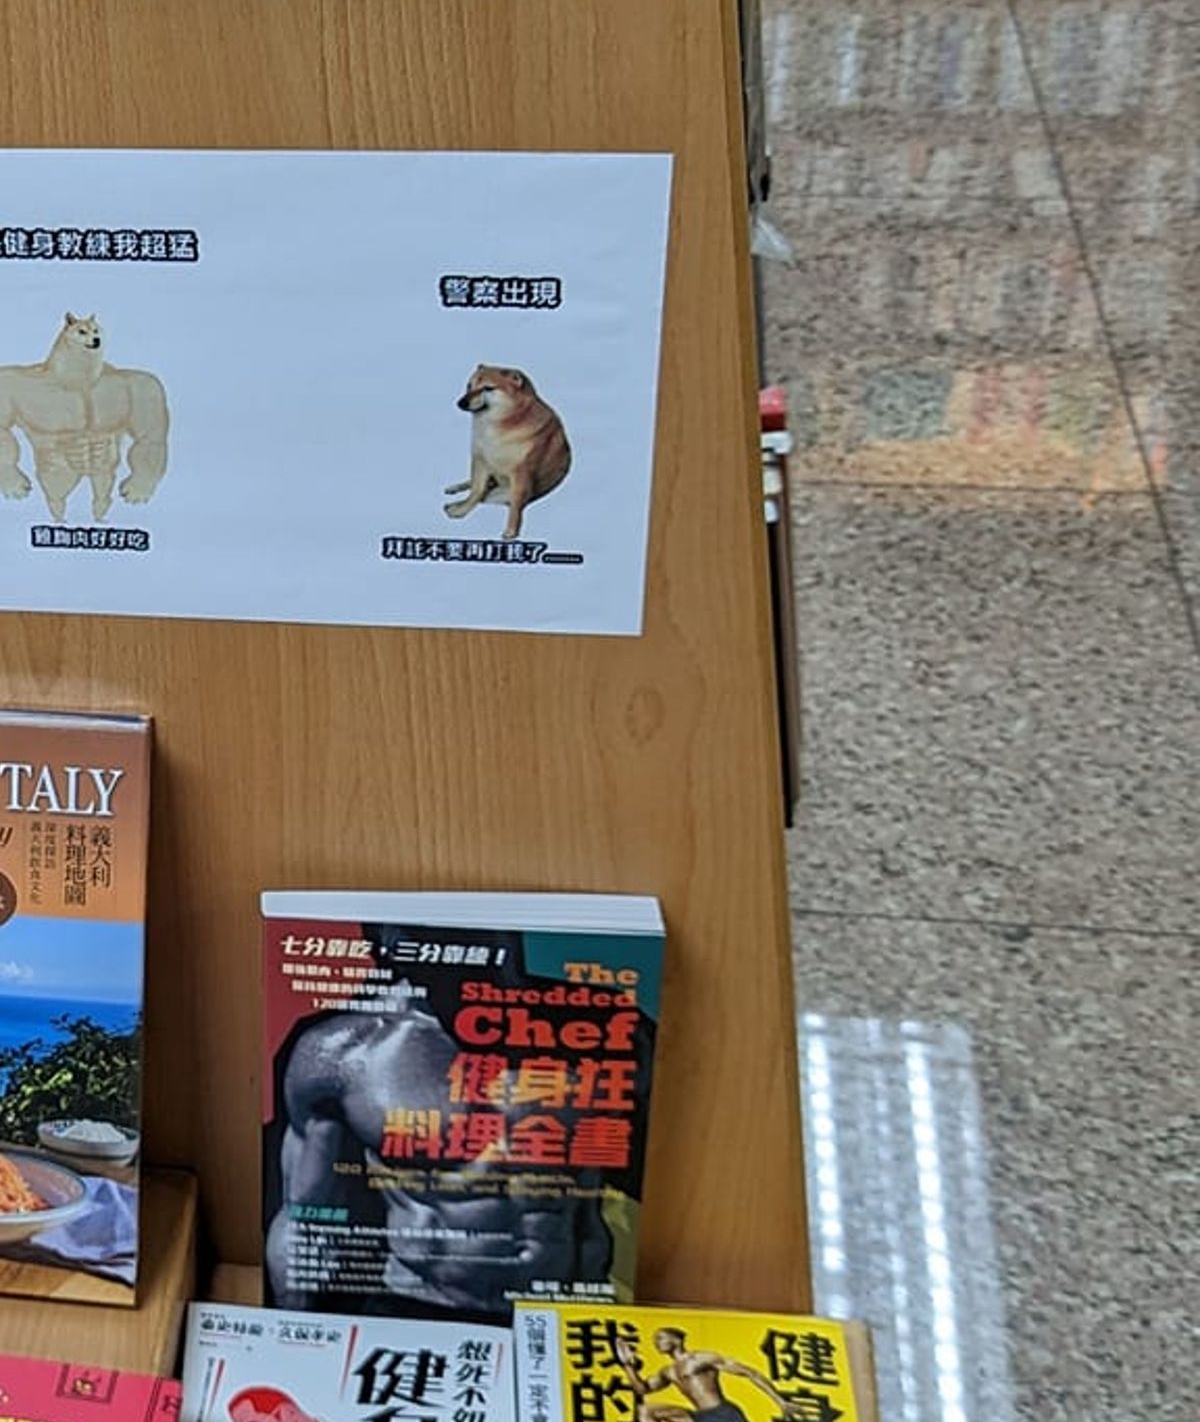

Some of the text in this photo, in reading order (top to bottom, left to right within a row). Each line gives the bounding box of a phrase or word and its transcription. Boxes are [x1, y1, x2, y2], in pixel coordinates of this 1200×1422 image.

[441, 276, 561, 307] 警察出現
[63, 824, 87, 907] 料理地圖
[90, 824, 112, 889] 義大利
[460, 981, 639, 1007] Shredded
[563, 962, 640, 985] The
[453, 1005, 640, 1051] Chef
[447, 1052, 638, 1111] 健身狂
[380, 1109, 634, 1169] 料理全書
